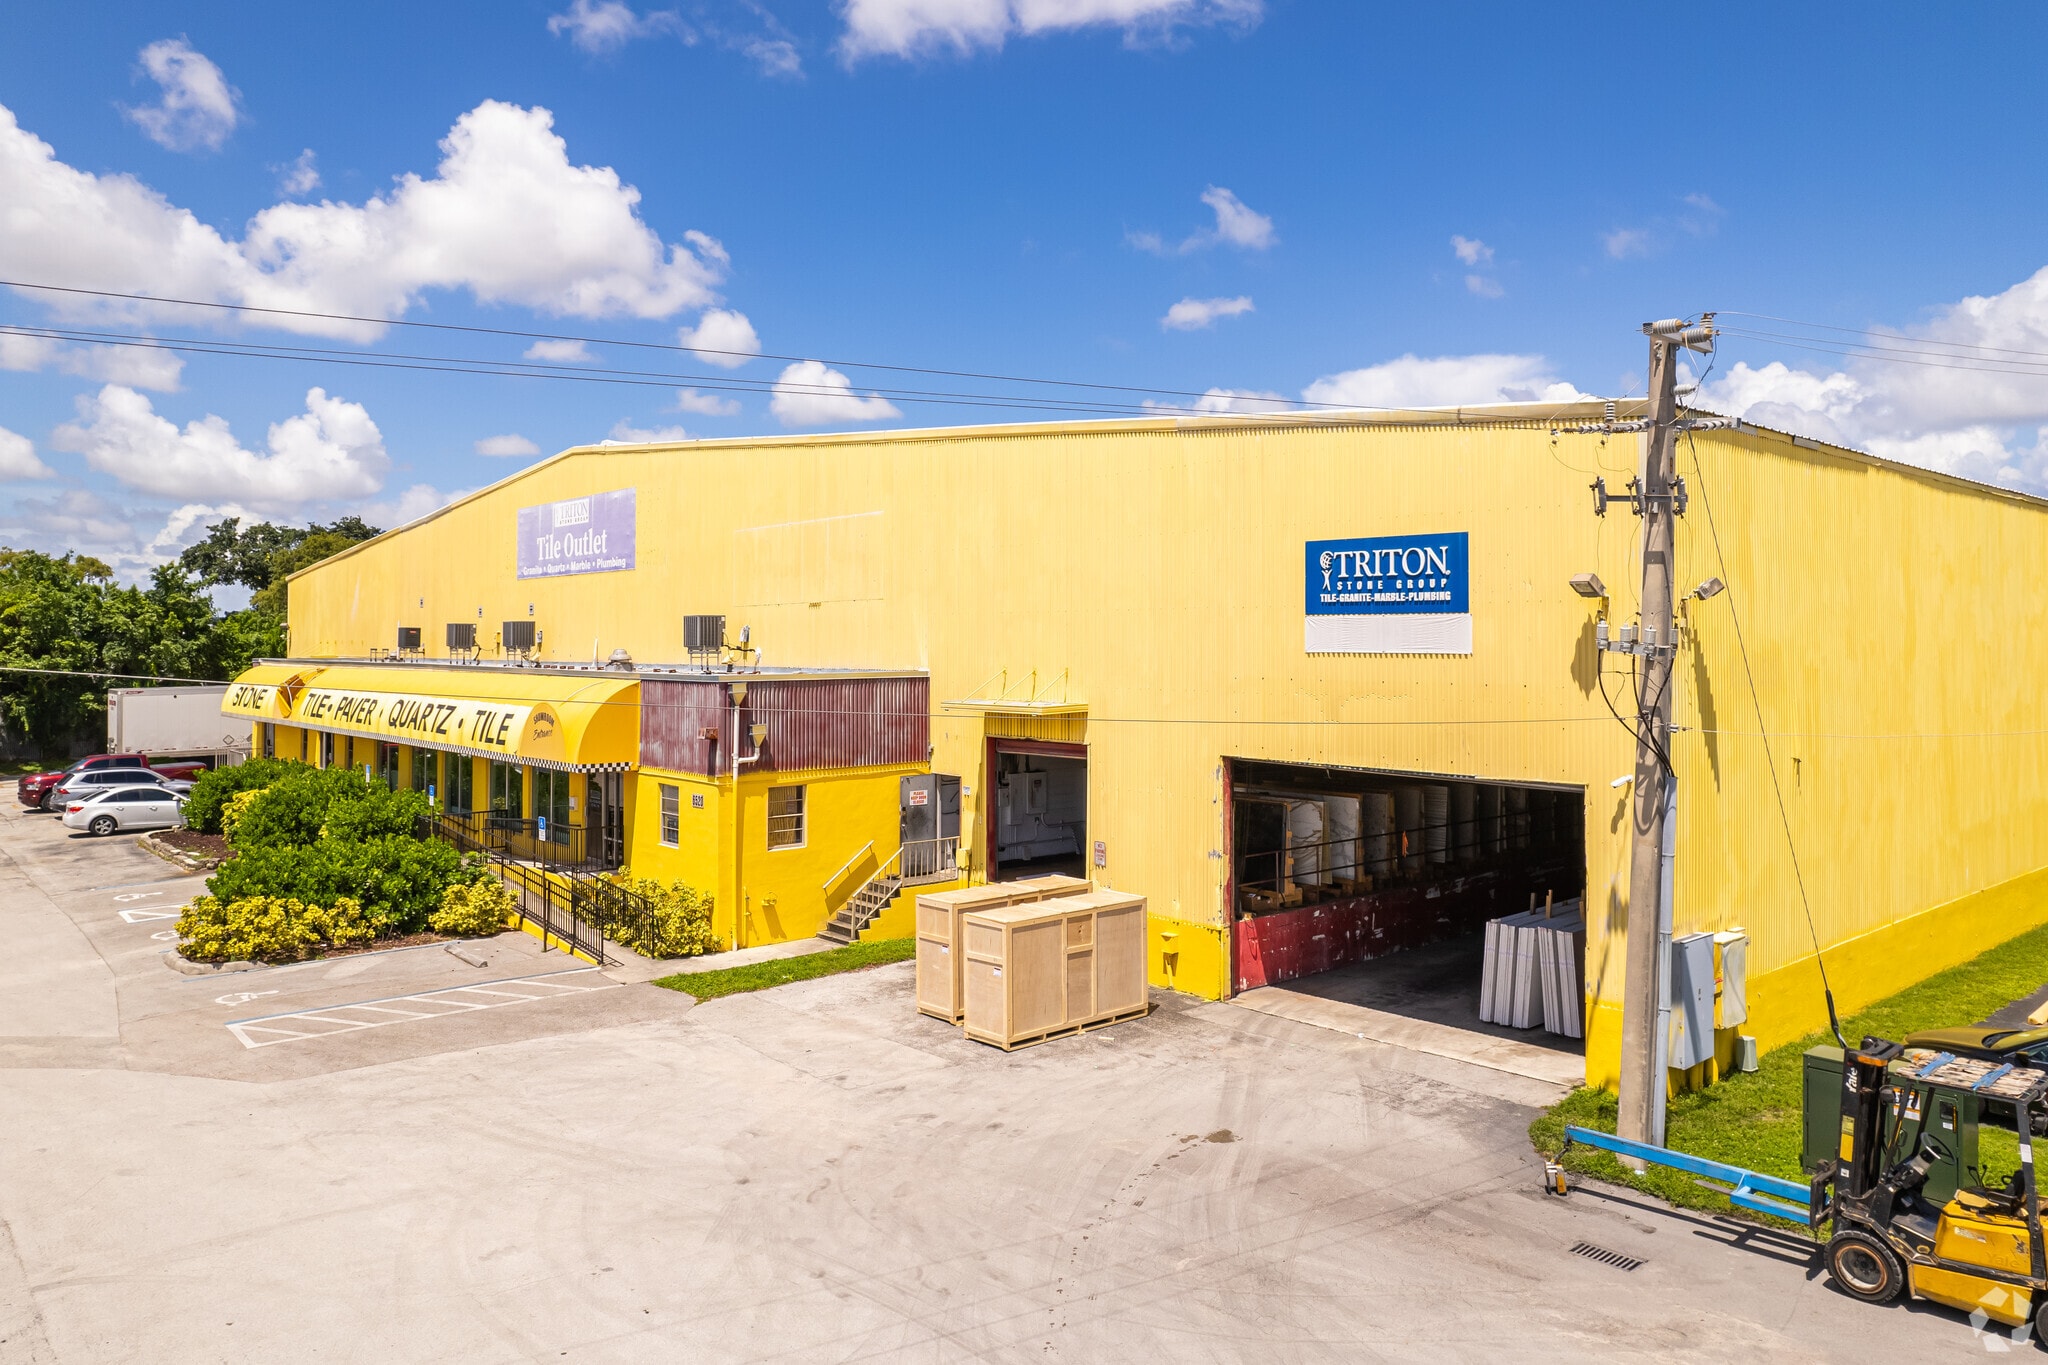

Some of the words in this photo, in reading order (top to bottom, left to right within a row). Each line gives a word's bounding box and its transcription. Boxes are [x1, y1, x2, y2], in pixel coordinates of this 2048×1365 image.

[561, 502, 589, 518] TRITON
[537, 534, 561, 561] Tile
[564, 528, 608, 557] Outlet
[523, 566, 543, 576] Granite
[547, 563, 566, 573] Quartz
[570, 560, 591, 571] Marble
[596, 556, 626, 569] Plumbing
[1334, 546, 1449, 578] TRITON
[1336, 580, 1384, 590] STONE
[1396, 578, 1448, 589] GROUP
[1320, 591, 1452, 603] TILE-GRANITE-MARBLE-PLUMBING
[303, 693, 331, 719] TILE
[334, 696, 378, 726] PAVER
[388, 699, 457, 735] QUARTZ
[471, 709, 515, 746] TILE
[1845, 1067, 1858, 1093] Yale
